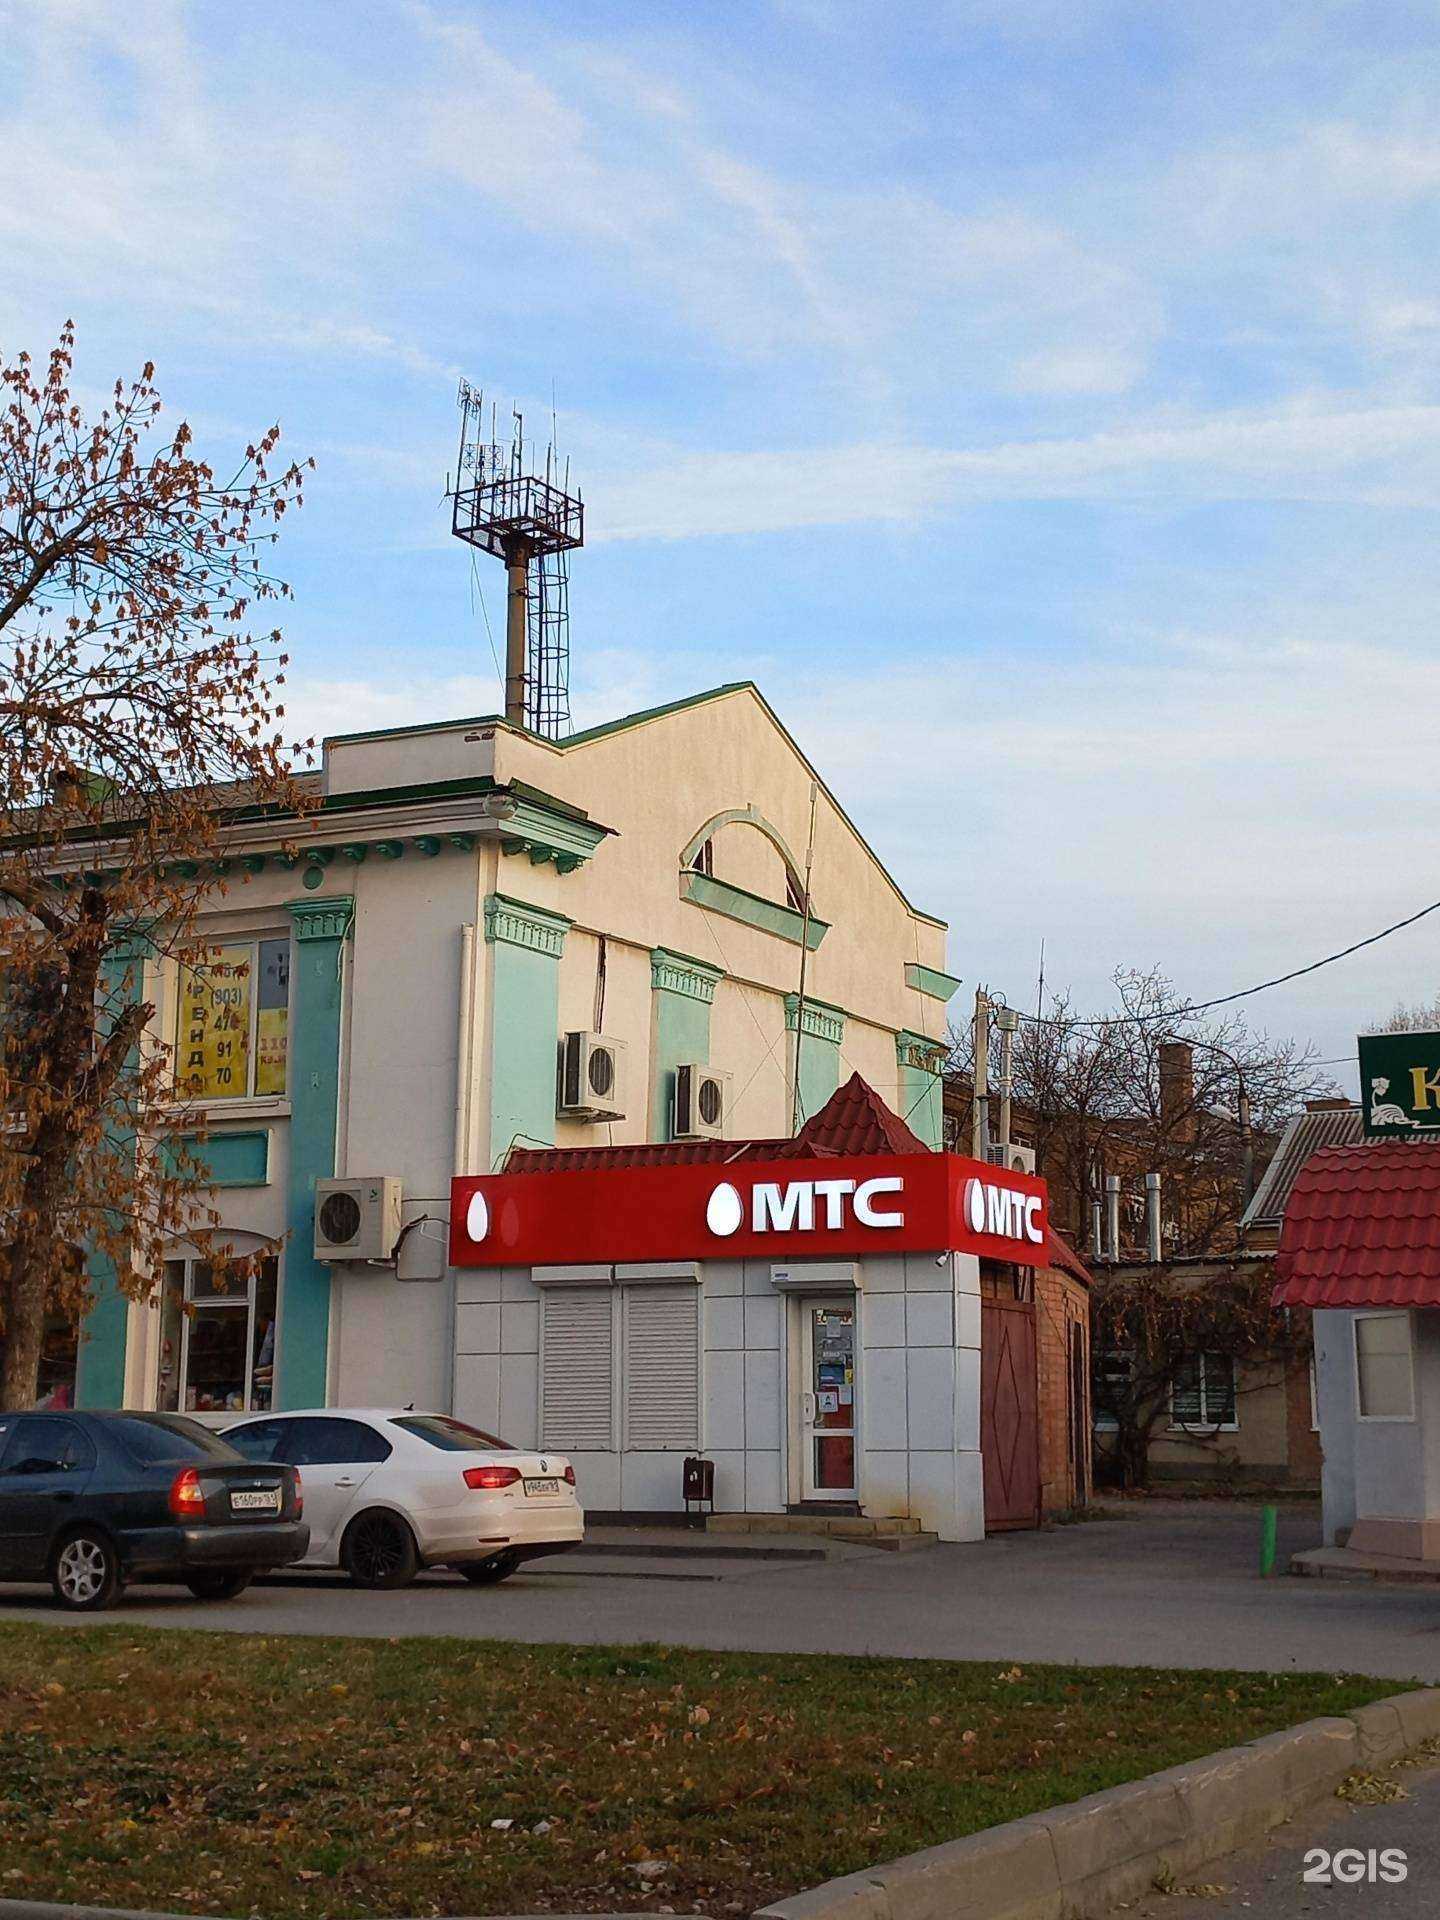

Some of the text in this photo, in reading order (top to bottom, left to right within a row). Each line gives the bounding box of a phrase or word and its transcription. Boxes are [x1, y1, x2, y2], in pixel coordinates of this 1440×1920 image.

[216, 1040, 232, 1058] 91
[216, 1067, 232, 1085] 70
[752, 1177, 904, 1233] МТС
[984, 1184, 1044, 1244] МТС
